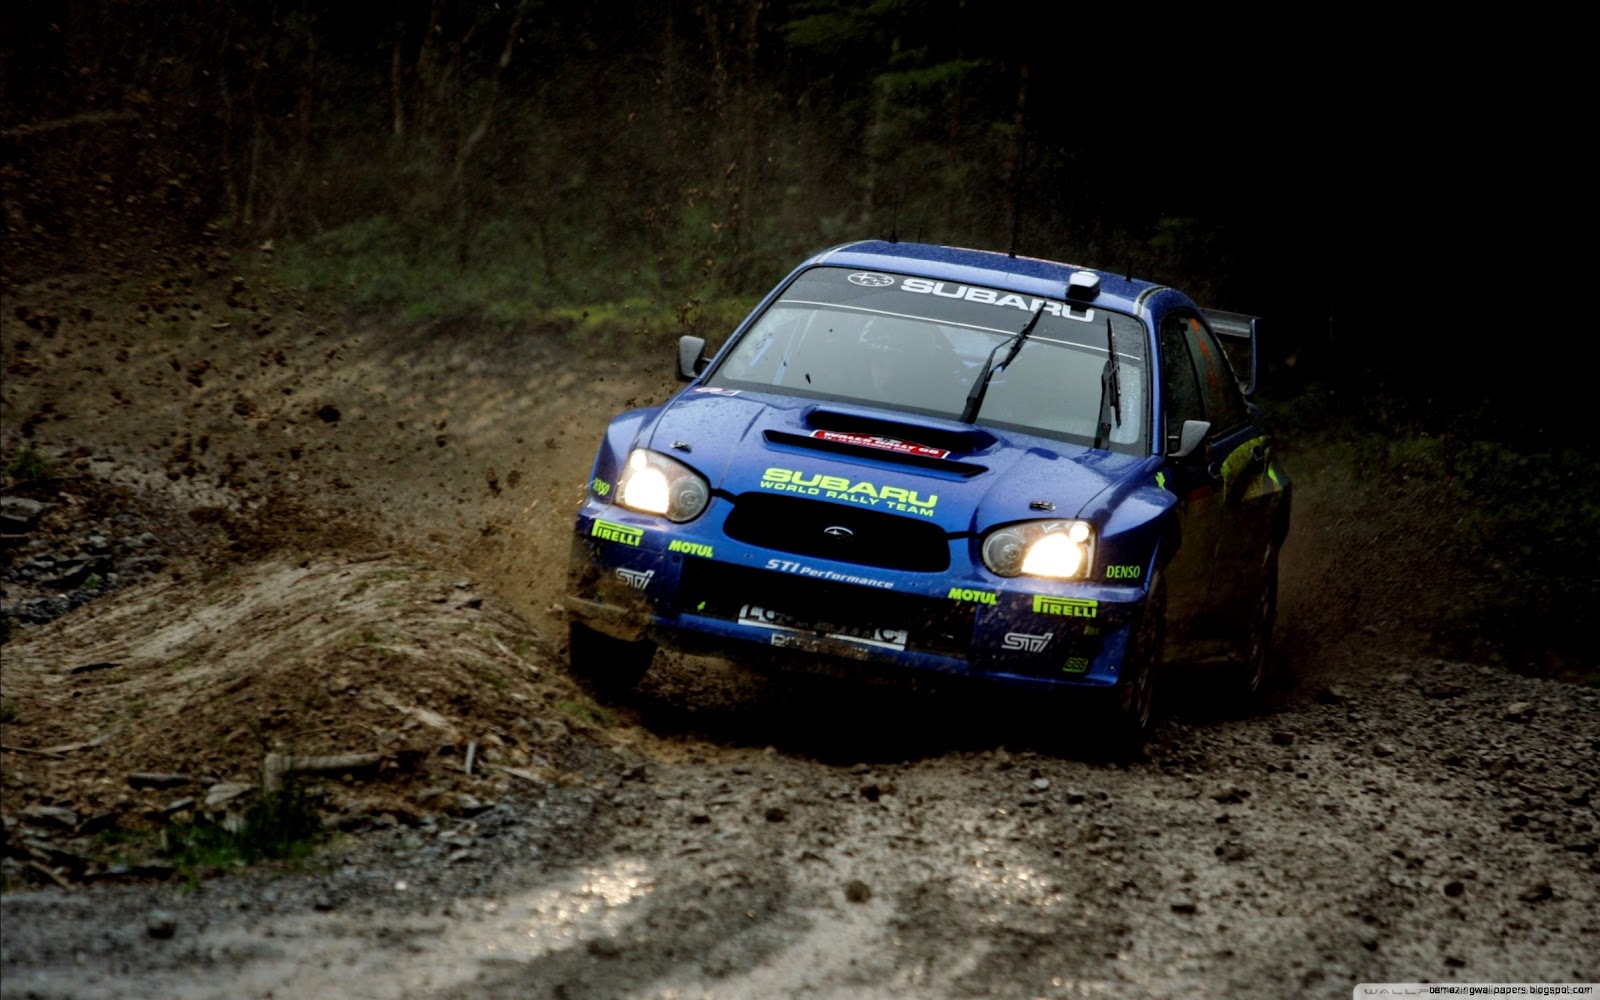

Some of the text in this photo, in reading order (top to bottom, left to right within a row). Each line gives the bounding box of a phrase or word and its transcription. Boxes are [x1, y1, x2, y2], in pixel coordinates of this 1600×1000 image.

[900, 278, 1095, 323] SUBARU
[760, 480, 934, 517] WORLD RALLY TEAM
[761, 467, 939, 508] SUBARU
[591, 518, 645, 547] PIRELLI
[668, 539, 714, 558] MOTUL
[765, 558, 894, 590] STI Performance
[1106, 564, 1141, 579] DENSO
[948, 587, 998, 606] MOTUL
[1032, 594, 1098, 618] PIRELLI
